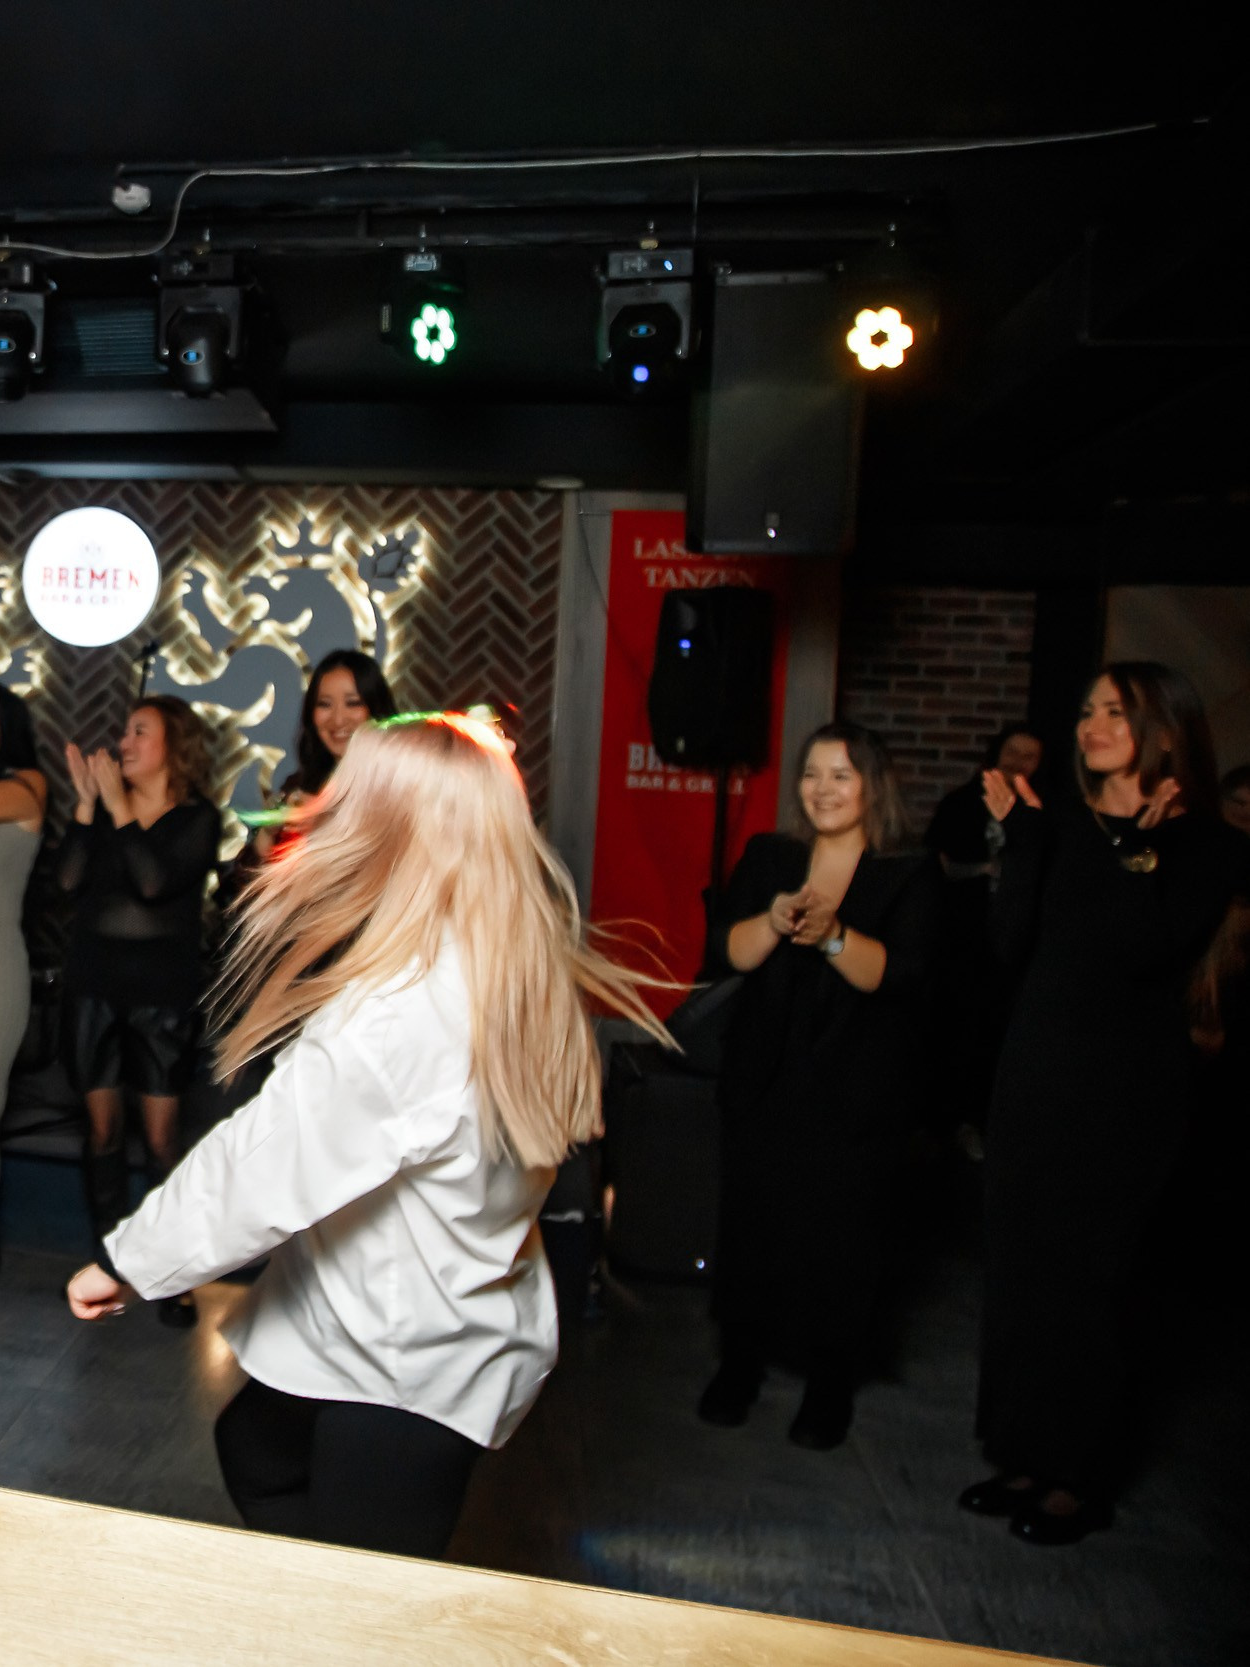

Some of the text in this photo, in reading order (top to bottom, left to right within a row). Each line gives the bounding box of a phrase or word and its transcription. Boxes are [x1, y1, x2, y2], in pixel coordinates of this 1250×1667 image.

[633, 536, 704, 561] LAS
[42, 565, 142, 592] BREMEN
[626, 774, 664, 790] BAR
